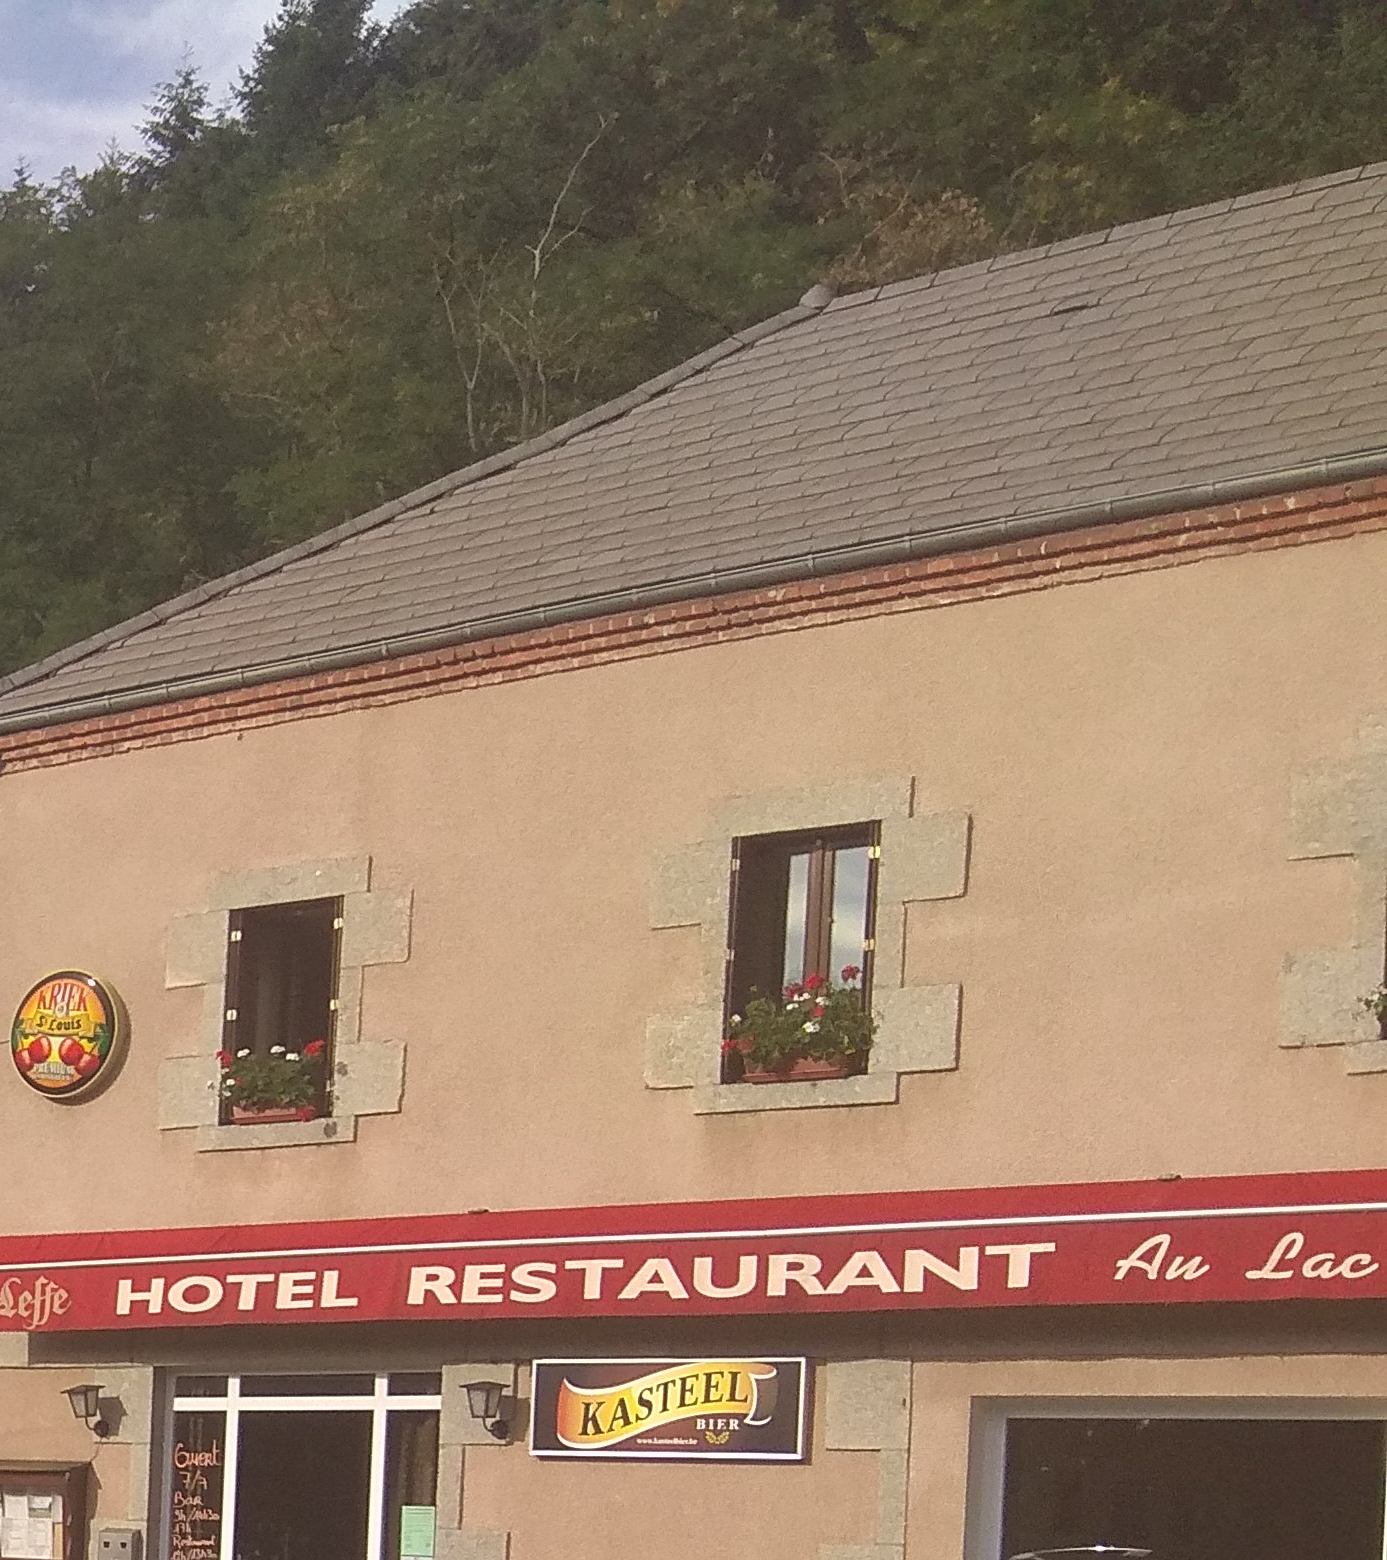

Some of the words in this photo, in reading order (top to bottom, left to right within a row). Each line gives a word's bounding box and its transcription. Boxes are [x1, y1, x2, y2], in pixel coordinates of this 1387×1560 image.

[37, 982, 88, 1011] KRIEK
[47, 1019, 82, 1031] Louis
[116, 1270, 357, 1315] HOTEL
[407, 1242, 1057, 1305] RESTAURANT
[1114, 1233, 1210, 1280] Au
[1244, 1232, 1380, 1279] Lac
[578, 1371, 748, 1436] KASTEEL
[696, 1418, 739, 1430] BIER
